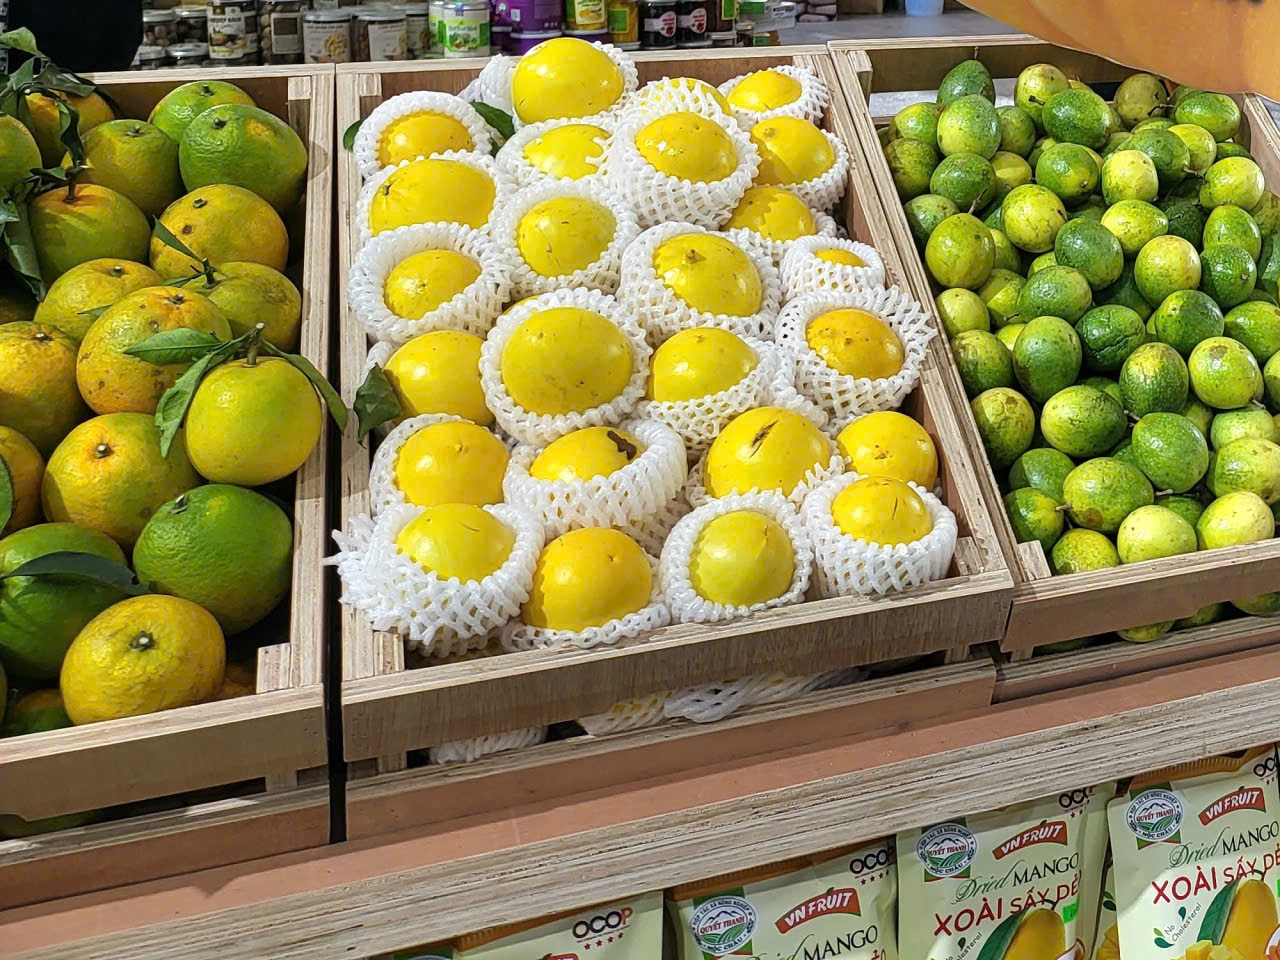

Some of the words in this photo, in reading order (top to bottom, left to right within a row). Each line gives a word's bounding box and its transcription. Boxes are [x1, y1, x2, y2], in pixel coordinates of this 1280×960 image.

[1205, 802, 1222, 820] VN
[1224, 791, 1260, 809] FRUIT
[1001, 837, 1020, 854] VN
[1023, 824, 1063, 845] FRUIT
[1165, 826, 1230, 869] Dried
[1222, 821, 1280, 856] MANGO
[951, 859, 1025, 905] Dried
[1013, 852, 1079, 887] MANGO
[1152, 866, 1218, 905] XOÀI
[1223, 856, 1257, 885] SẤY
[572, 907, 633, 939] OCOP
[784, 906, 806, 927] VN
[808, 892, 853, 915] FRUIT
[934, 897, 1003, 936] XOÀI
[1010, 886, 1050, 916] SẤY
[1171, 903, 1202, 942] Cholesterol
[803, 924, 878, 960] MANGO
